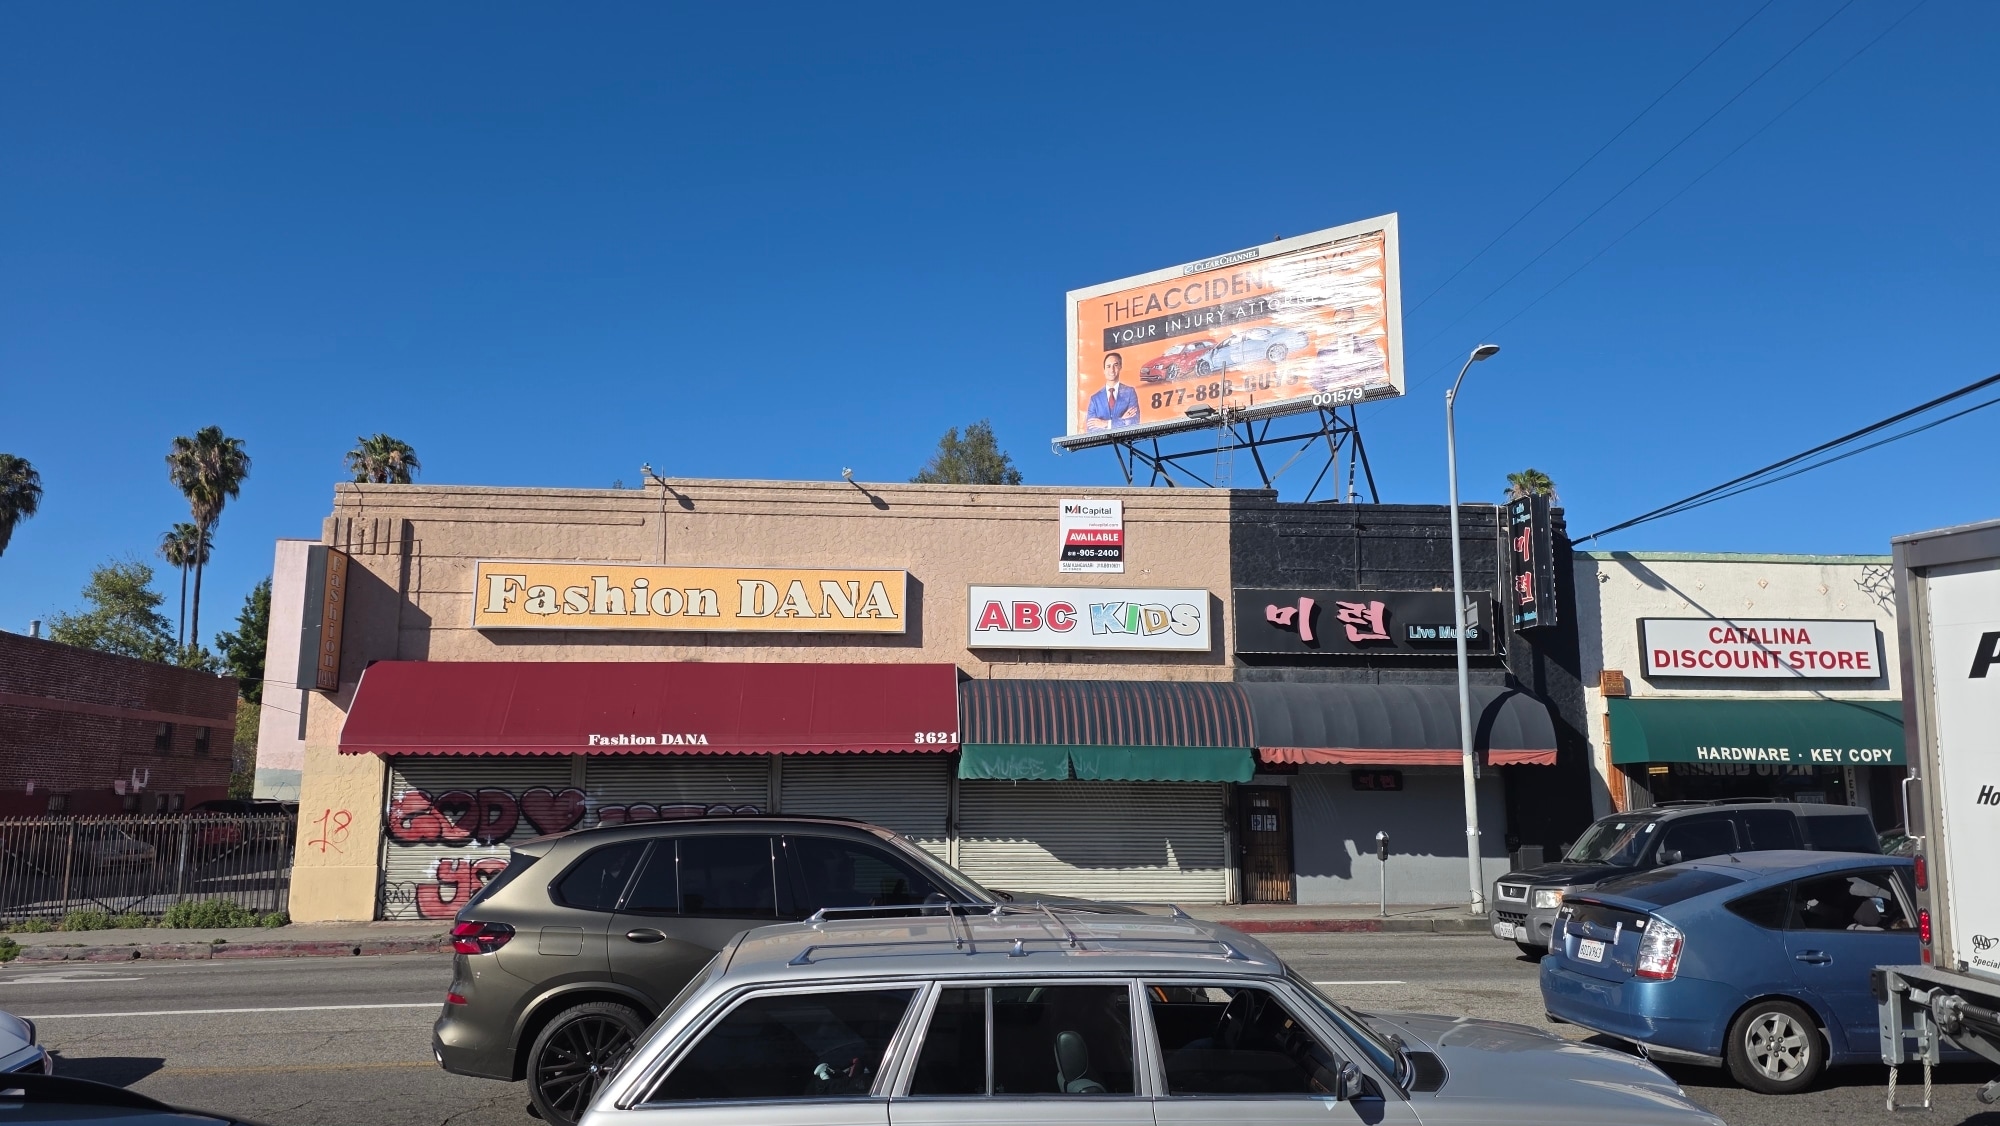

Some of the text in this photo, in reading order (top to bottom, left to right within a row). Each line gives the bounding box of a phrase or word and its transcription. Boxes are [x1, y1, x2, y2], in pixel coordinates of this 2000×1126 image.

[1112, 324, 1156, 343] YOUR
[1165, 310, 1225, 333] INJURY
[1312, 387, 1363, 406] 001579
[1082, 507, 1112, 515] Capital
[1070, 533, 1119, 541] AVAILABLE
[483, 574, 899, 619] Fashion DANA
[327, 555, 342, 667] Fashion
[975, 600, 1201, 637] ABC KIDS
[1409, 625, 1478, 639] Live Muic
[1708, 627, 1812, 645] CATALINA
[1653, 650, 1872, 670] DISCOUNT STORE
[588, 732, 958, 746] Fashion DANA 3621
[1696, 746, 1893, 762] HARDWARE KEY COPY
